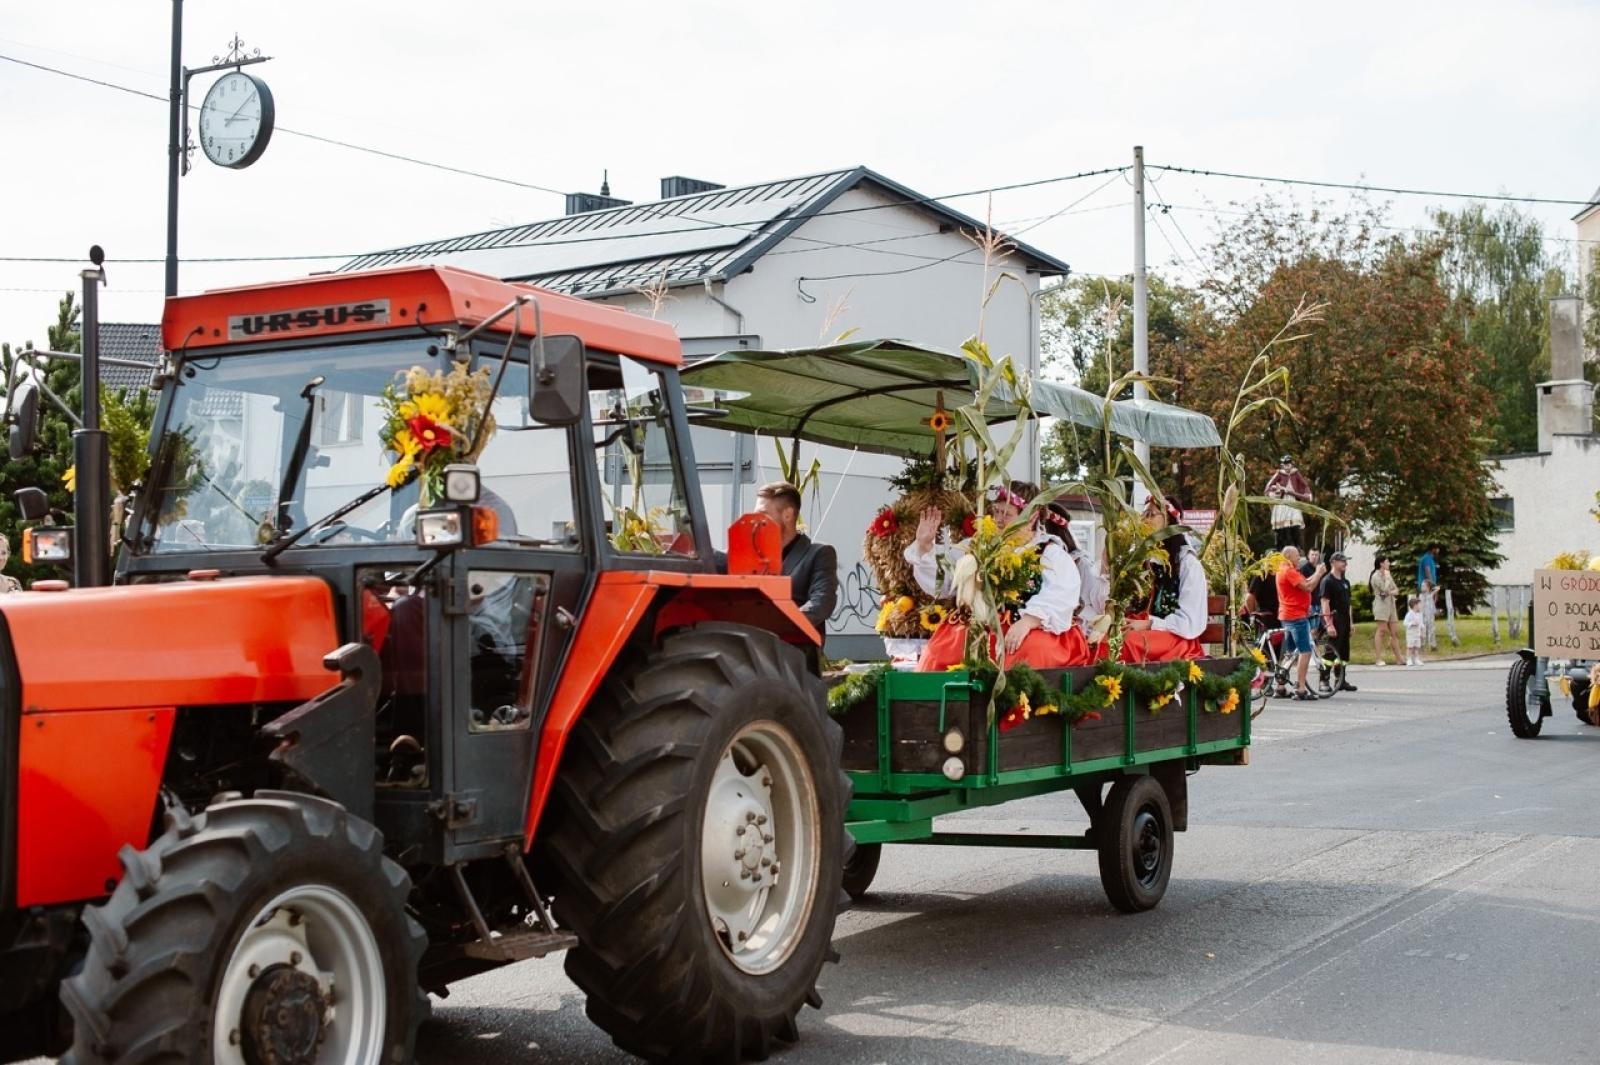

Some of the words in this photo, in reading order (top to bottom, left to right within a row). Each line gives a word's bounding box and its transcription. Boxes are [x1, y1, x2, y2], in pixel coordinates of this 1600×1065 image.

[241, 303, 377, 335] URSUS
[1540, 575, 1552, 591] W
[1548, 601, 1558, 616] O
[1547, 634, 1581, 649] DUŻO
